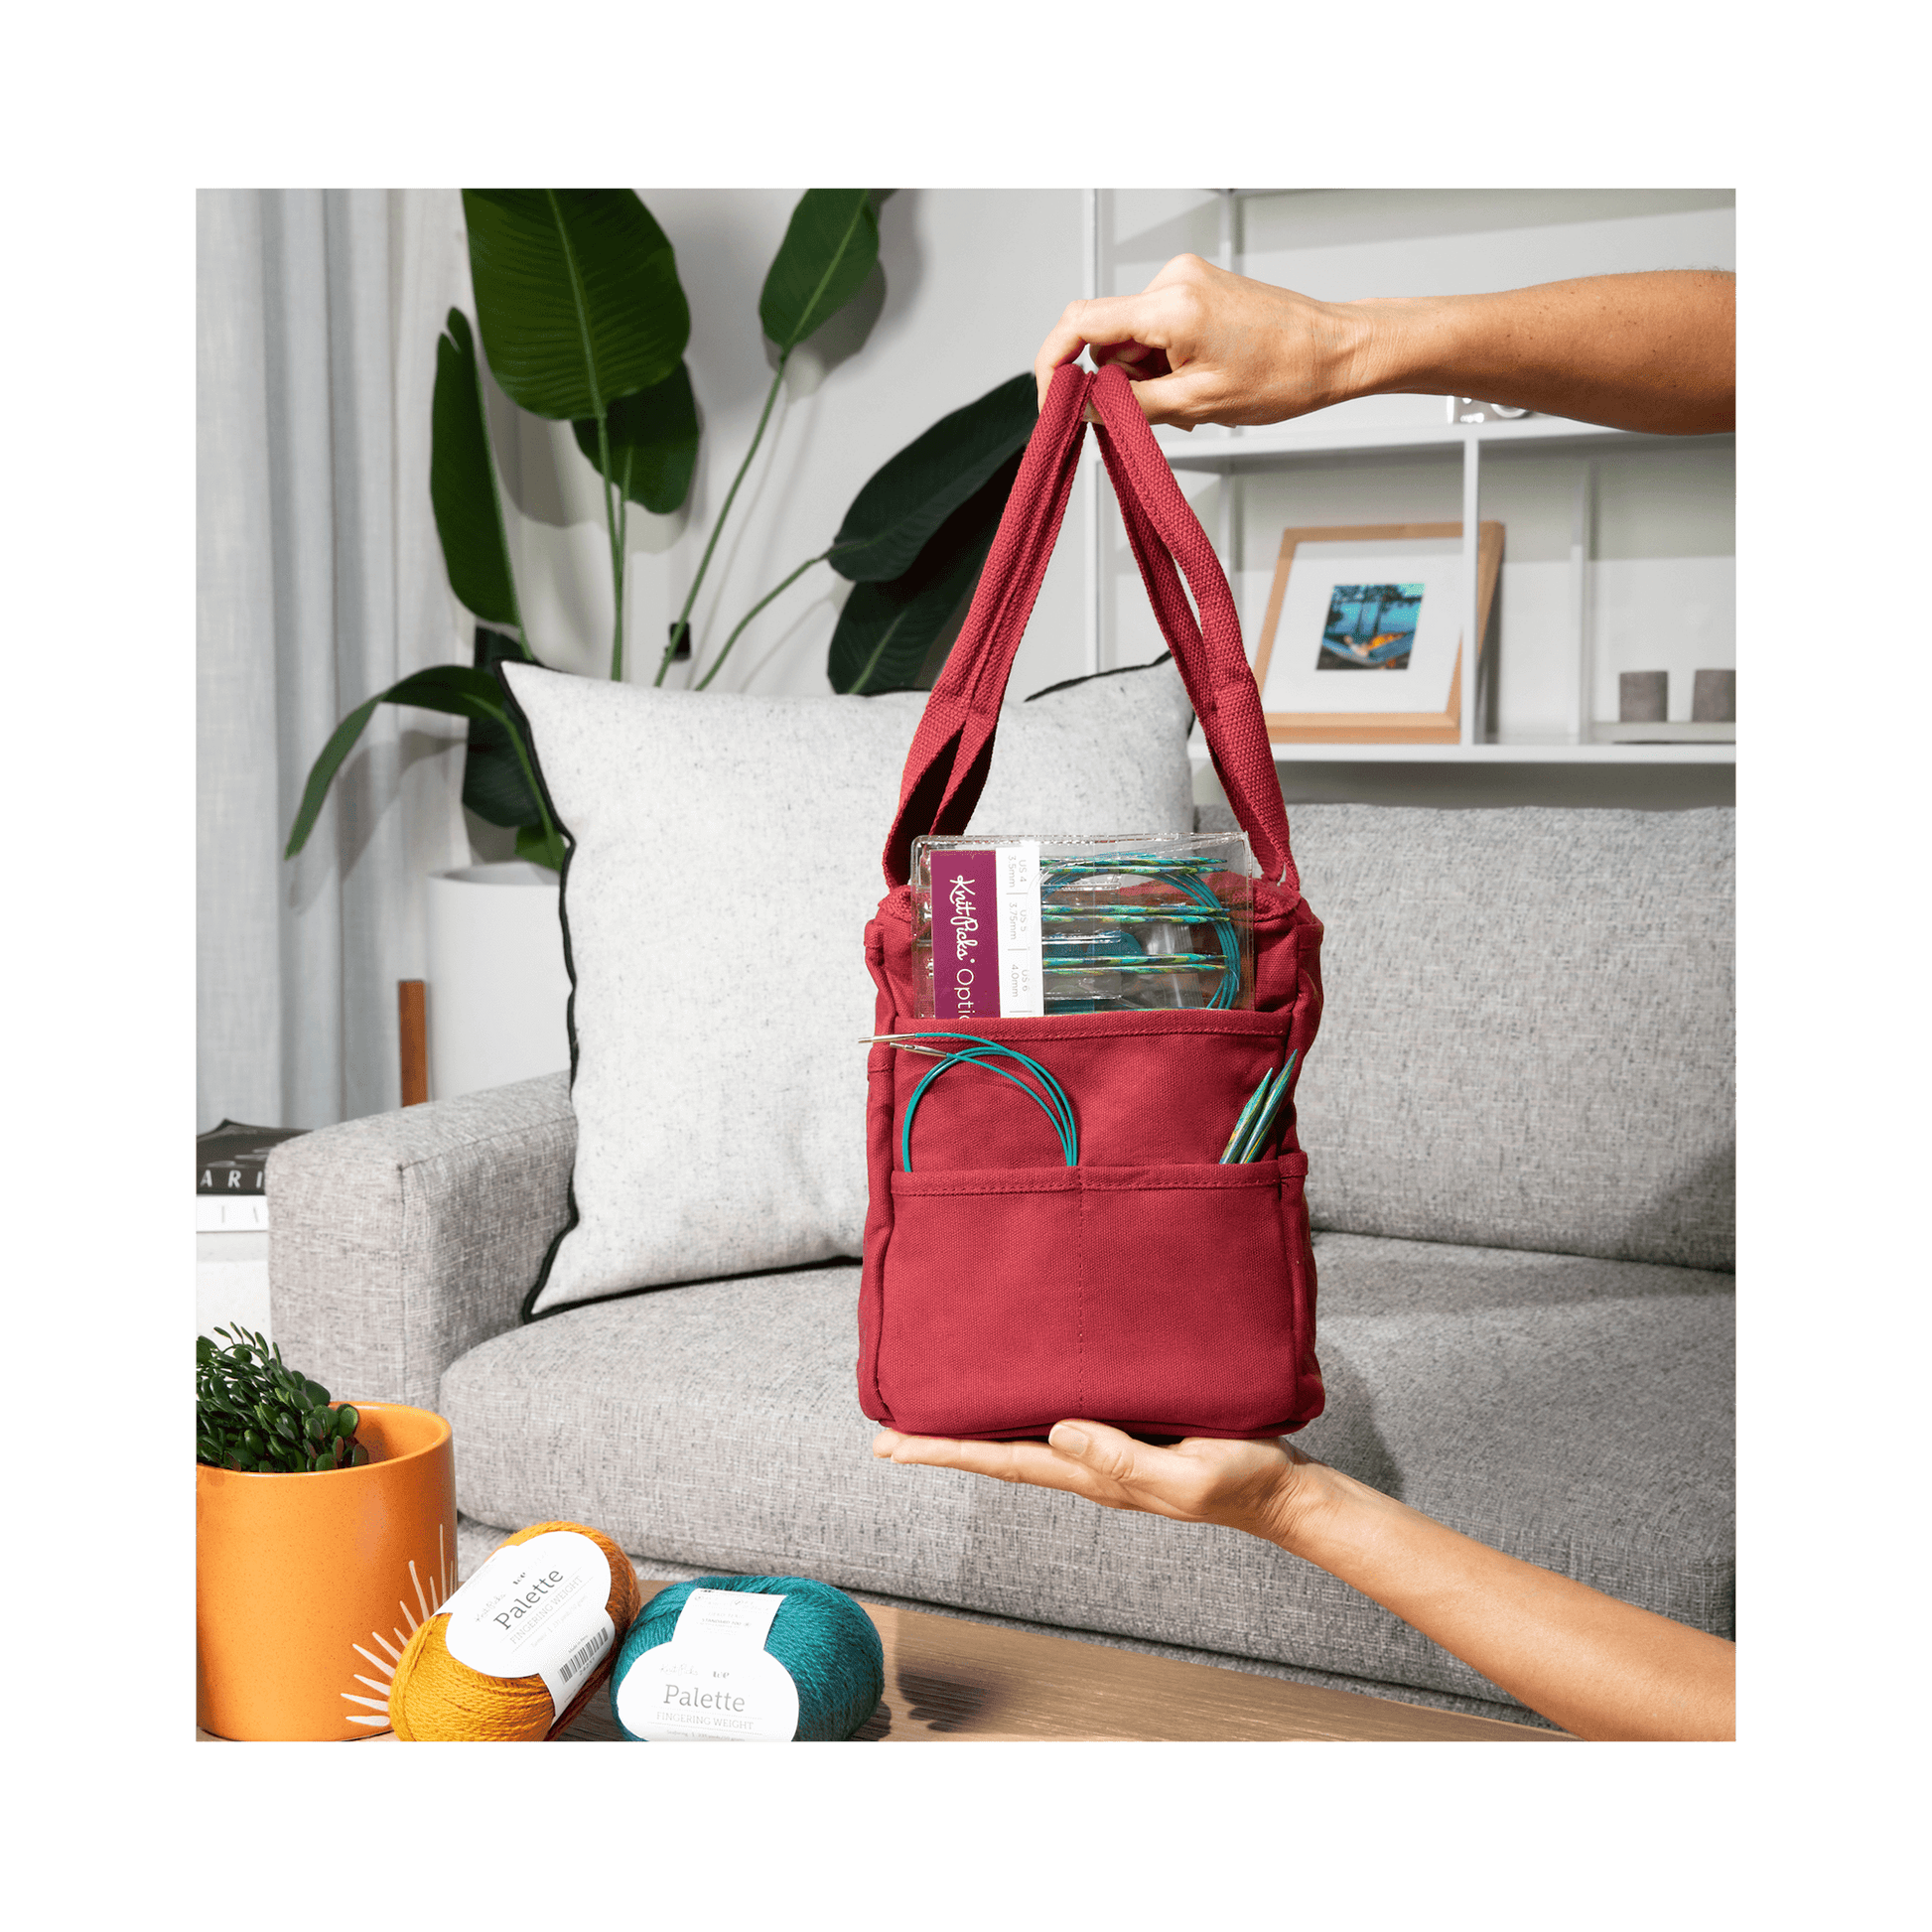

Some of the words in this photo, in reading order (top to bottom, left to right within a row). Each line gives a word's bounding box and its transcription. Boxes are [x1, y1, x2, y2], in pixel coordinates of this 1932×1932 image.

[1008, 855, 1018, 888] 3.5mm
[1019, 859, 1028, 874] US
[1009, 901, 1019, 940] 3.75mm
[1011, 964, 1021, 998] 4.0mm
[492, 1569, 564, 1631] Palette
[509, 1604, 554, 1645] FINGERING
[550, 1575, 584, 1605] WEIGHT
[712, 1670, 730, 1680] we
[663, 1684, 746, 1713] Palette
[656, 1711, 711, 1725] FINGERING
[713, 1718, 755, 1730] WEIGHT
